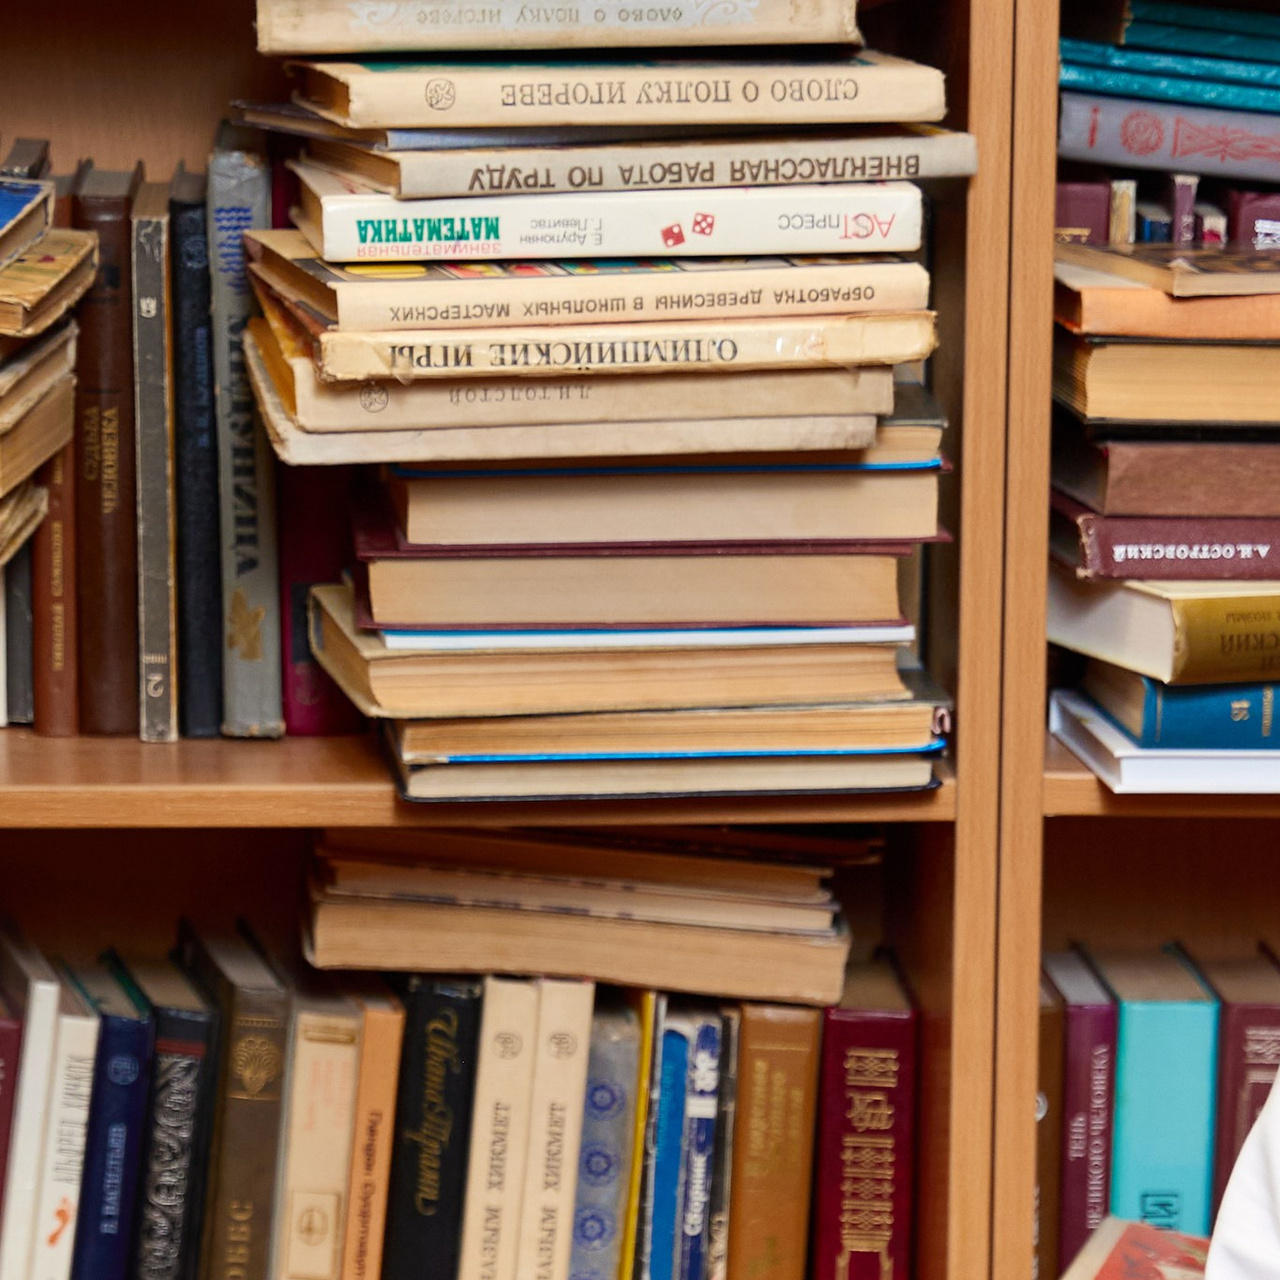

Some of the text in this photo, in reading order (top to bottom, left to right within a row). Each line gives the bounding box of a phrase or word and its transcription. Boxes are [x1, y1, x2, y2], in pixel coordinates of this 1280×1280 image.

[500, 77, 860, 108] СЛОВО О ПОЛКУ ИГОРЕВЕ
[468, 154, 920, 191] ВНЕКЛАССНАЯ РАБОТА ПО ТРУДУ
[356, 216, 500, 242] МАТЕМАТИКА
[520, 232, 586, 246] Арутюнян
[530, 219, 588, 232] Левитас
[356, 243, 501, 260] занимательная
[390, 286, 875, 322] ОБРАБОТКА ДРЕВЕСИНЫ В ШКОЛЬНЫХ МАСТЕРСКИХ
[388, 338, 738, 372] ОЛИМПИЙСКИЕ ИГРЫ
[487, 1101, 512, 1192] ХИКМЕТ
[543, 1101, 569, 1192] ХИКМЕТ
[1070, 1116, 1086, 1160] ТЕНЬ
[1085, 1047, 1109, 1229] ВЕЛИКОГО ЧЕЛОВЕКА
